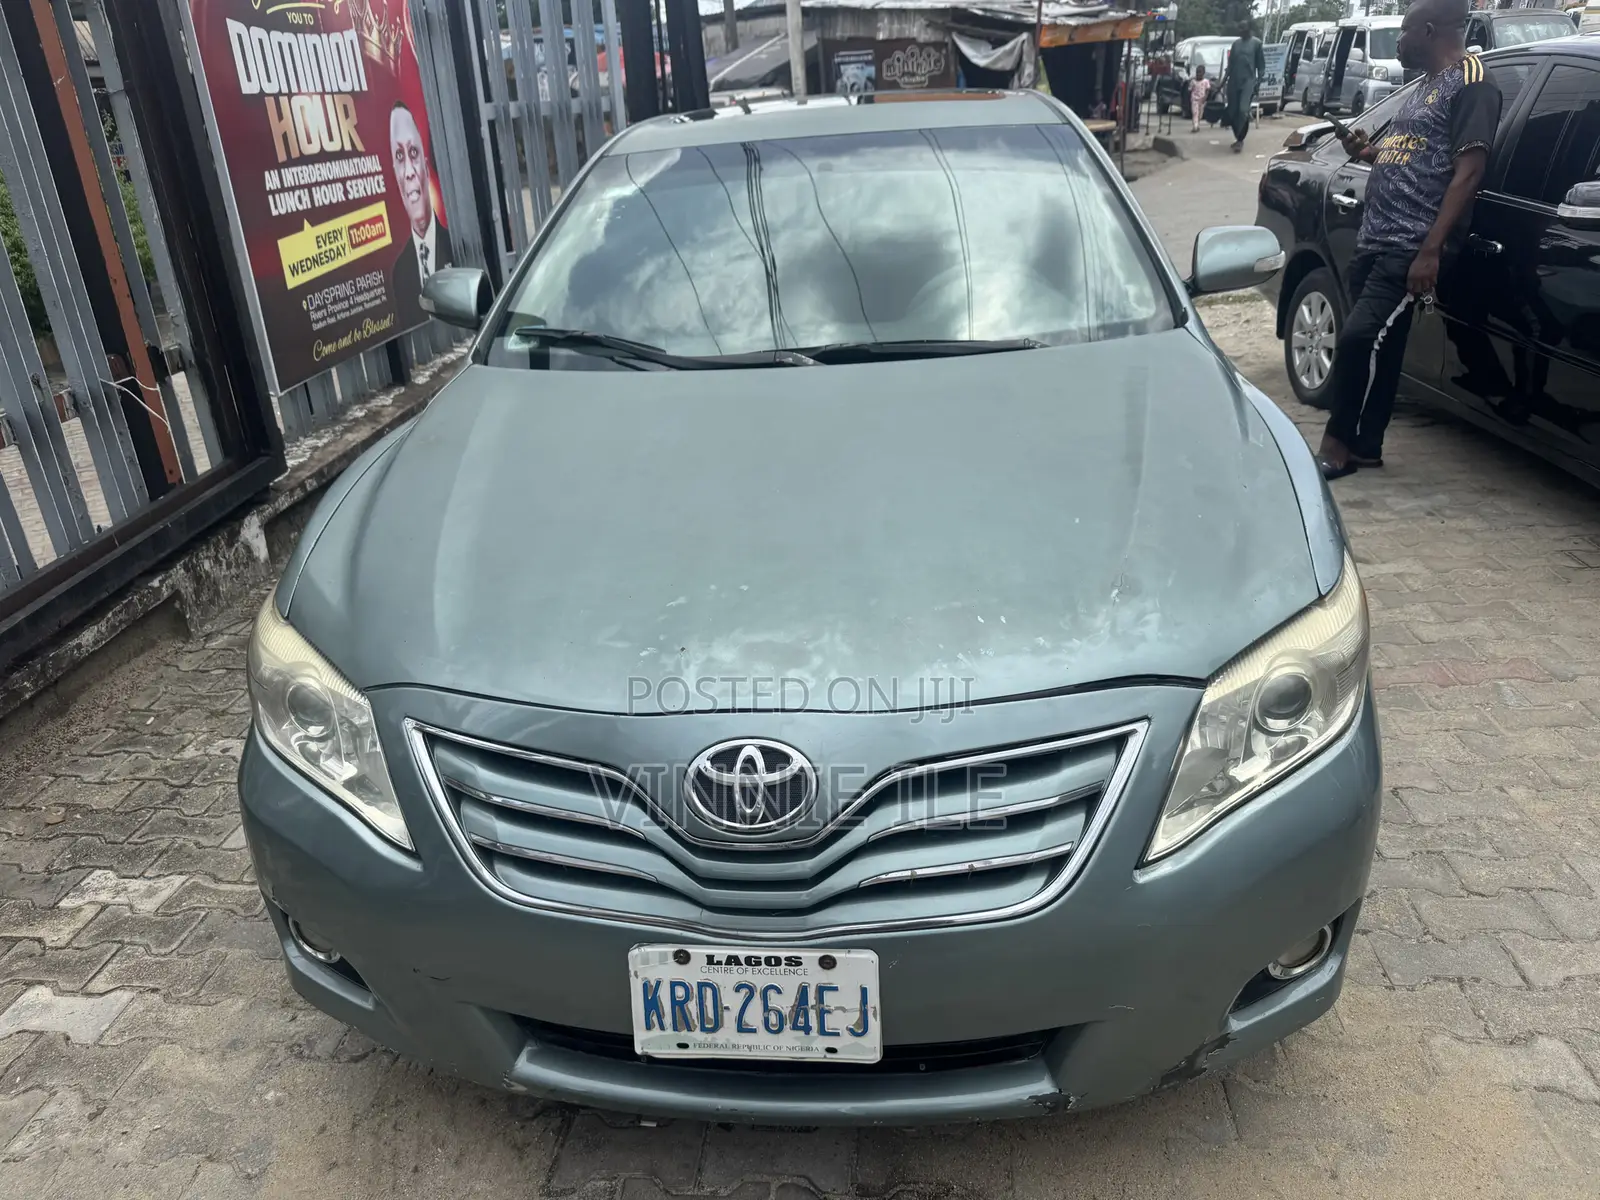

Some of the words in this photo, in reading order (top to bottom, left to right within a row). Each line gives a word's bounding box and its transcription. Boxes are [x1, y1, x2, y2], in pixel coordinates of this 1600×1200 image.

[286, 11, 302, 24] YOU
[303, 13, 314, 25] TO
[226, 18, 368, 94] DOMINION
[265, 94, 365, 163] HOUR
[264, 169, 281, 191] AN
[281, 154, 382, 187] INTERDENOMINATIONAL
[268, 188, 312, 216] LUNCH
[312, 182, 345, 207] HOUR
[346, 174, 386, 200] SERVICE
[315, 227, 345, 249] EVERY
[349, 221, 385, 244] 11:00am
[288, 243, 347, 278] WEDNESDAY
[306, 280, 355, 310] DAYSPRING
[355, 269, 385, 291] PARISH
[309, 308, 327, 321] Rivers
[327, 300, 349, 315] Province
[313, 339, 336, 361] Come
[337, 330, 353, 350] and
[353, 327, 362, 342] be
[362, 312, 394, 338] Blessed!
[700, 965, 735, 975] CENTRE
[736, 966, 749, 975] OF
[751, 966, 809, 976] EXCELLENCE
[705, 954, 803, 967] LAGOS
